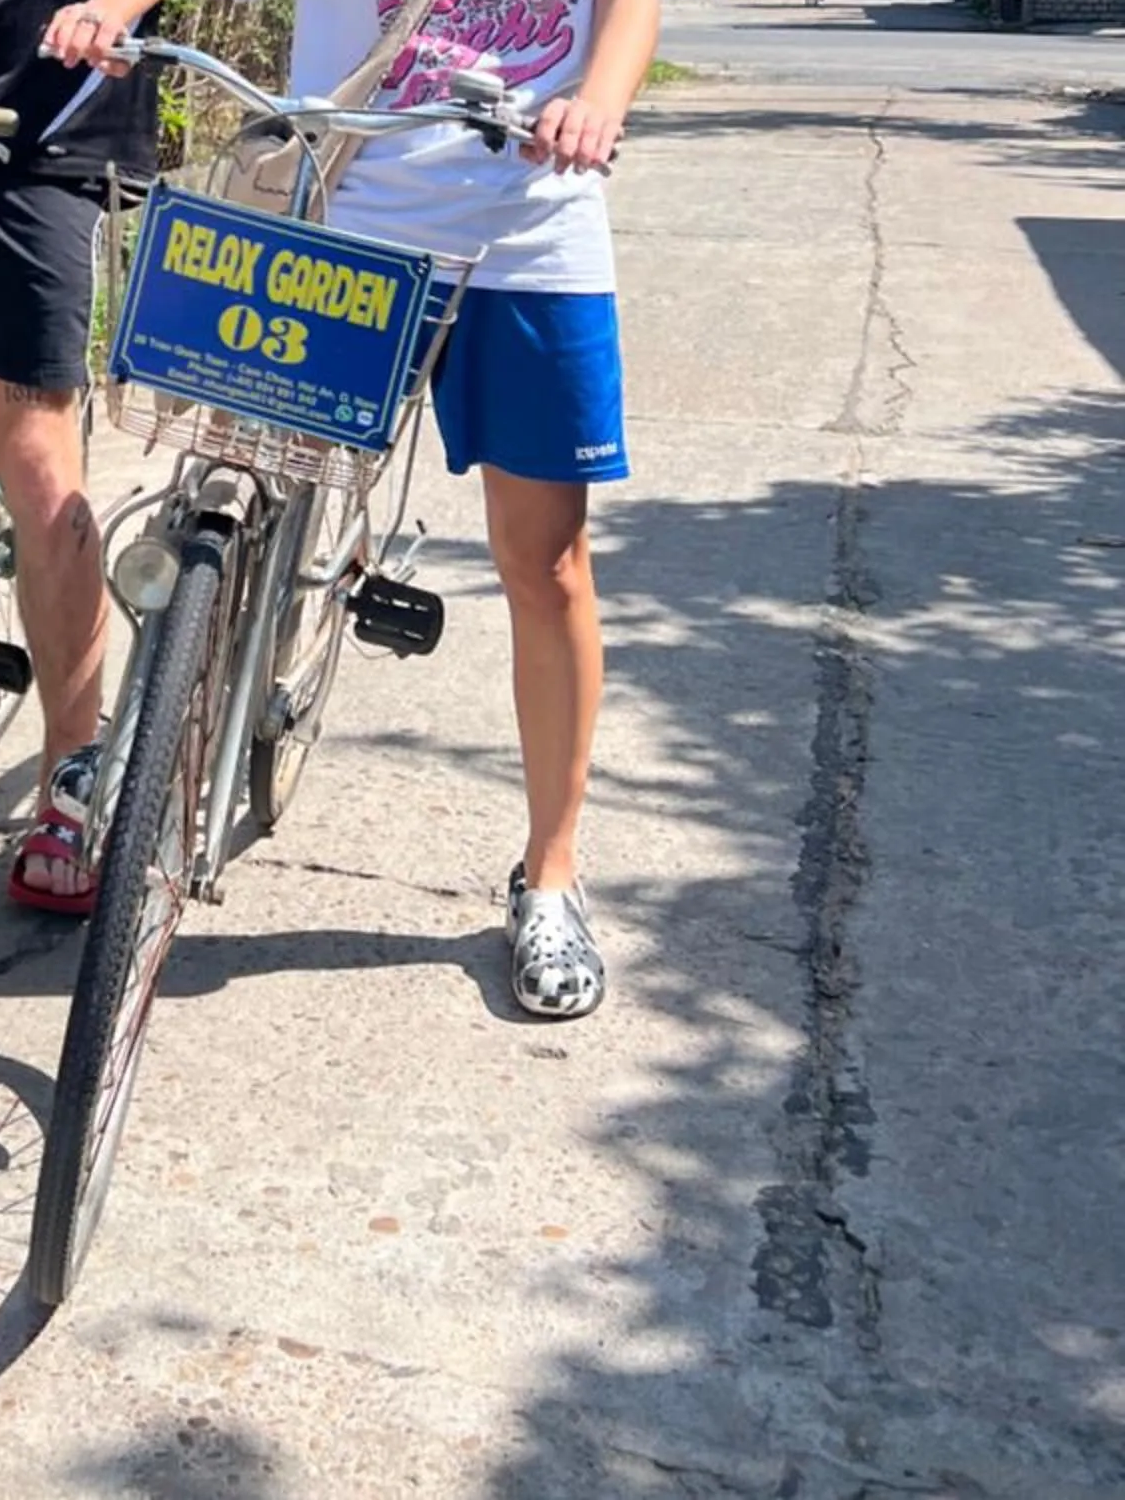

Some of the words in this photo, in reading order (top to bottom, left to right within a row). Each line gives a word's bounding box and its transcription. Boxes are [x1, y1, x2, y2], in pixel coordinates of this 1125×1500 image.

[162, 219, 265, 296] RELAX
[266, 250, 399, 332] GARDEN
[218, 304, 309, 364] 03
